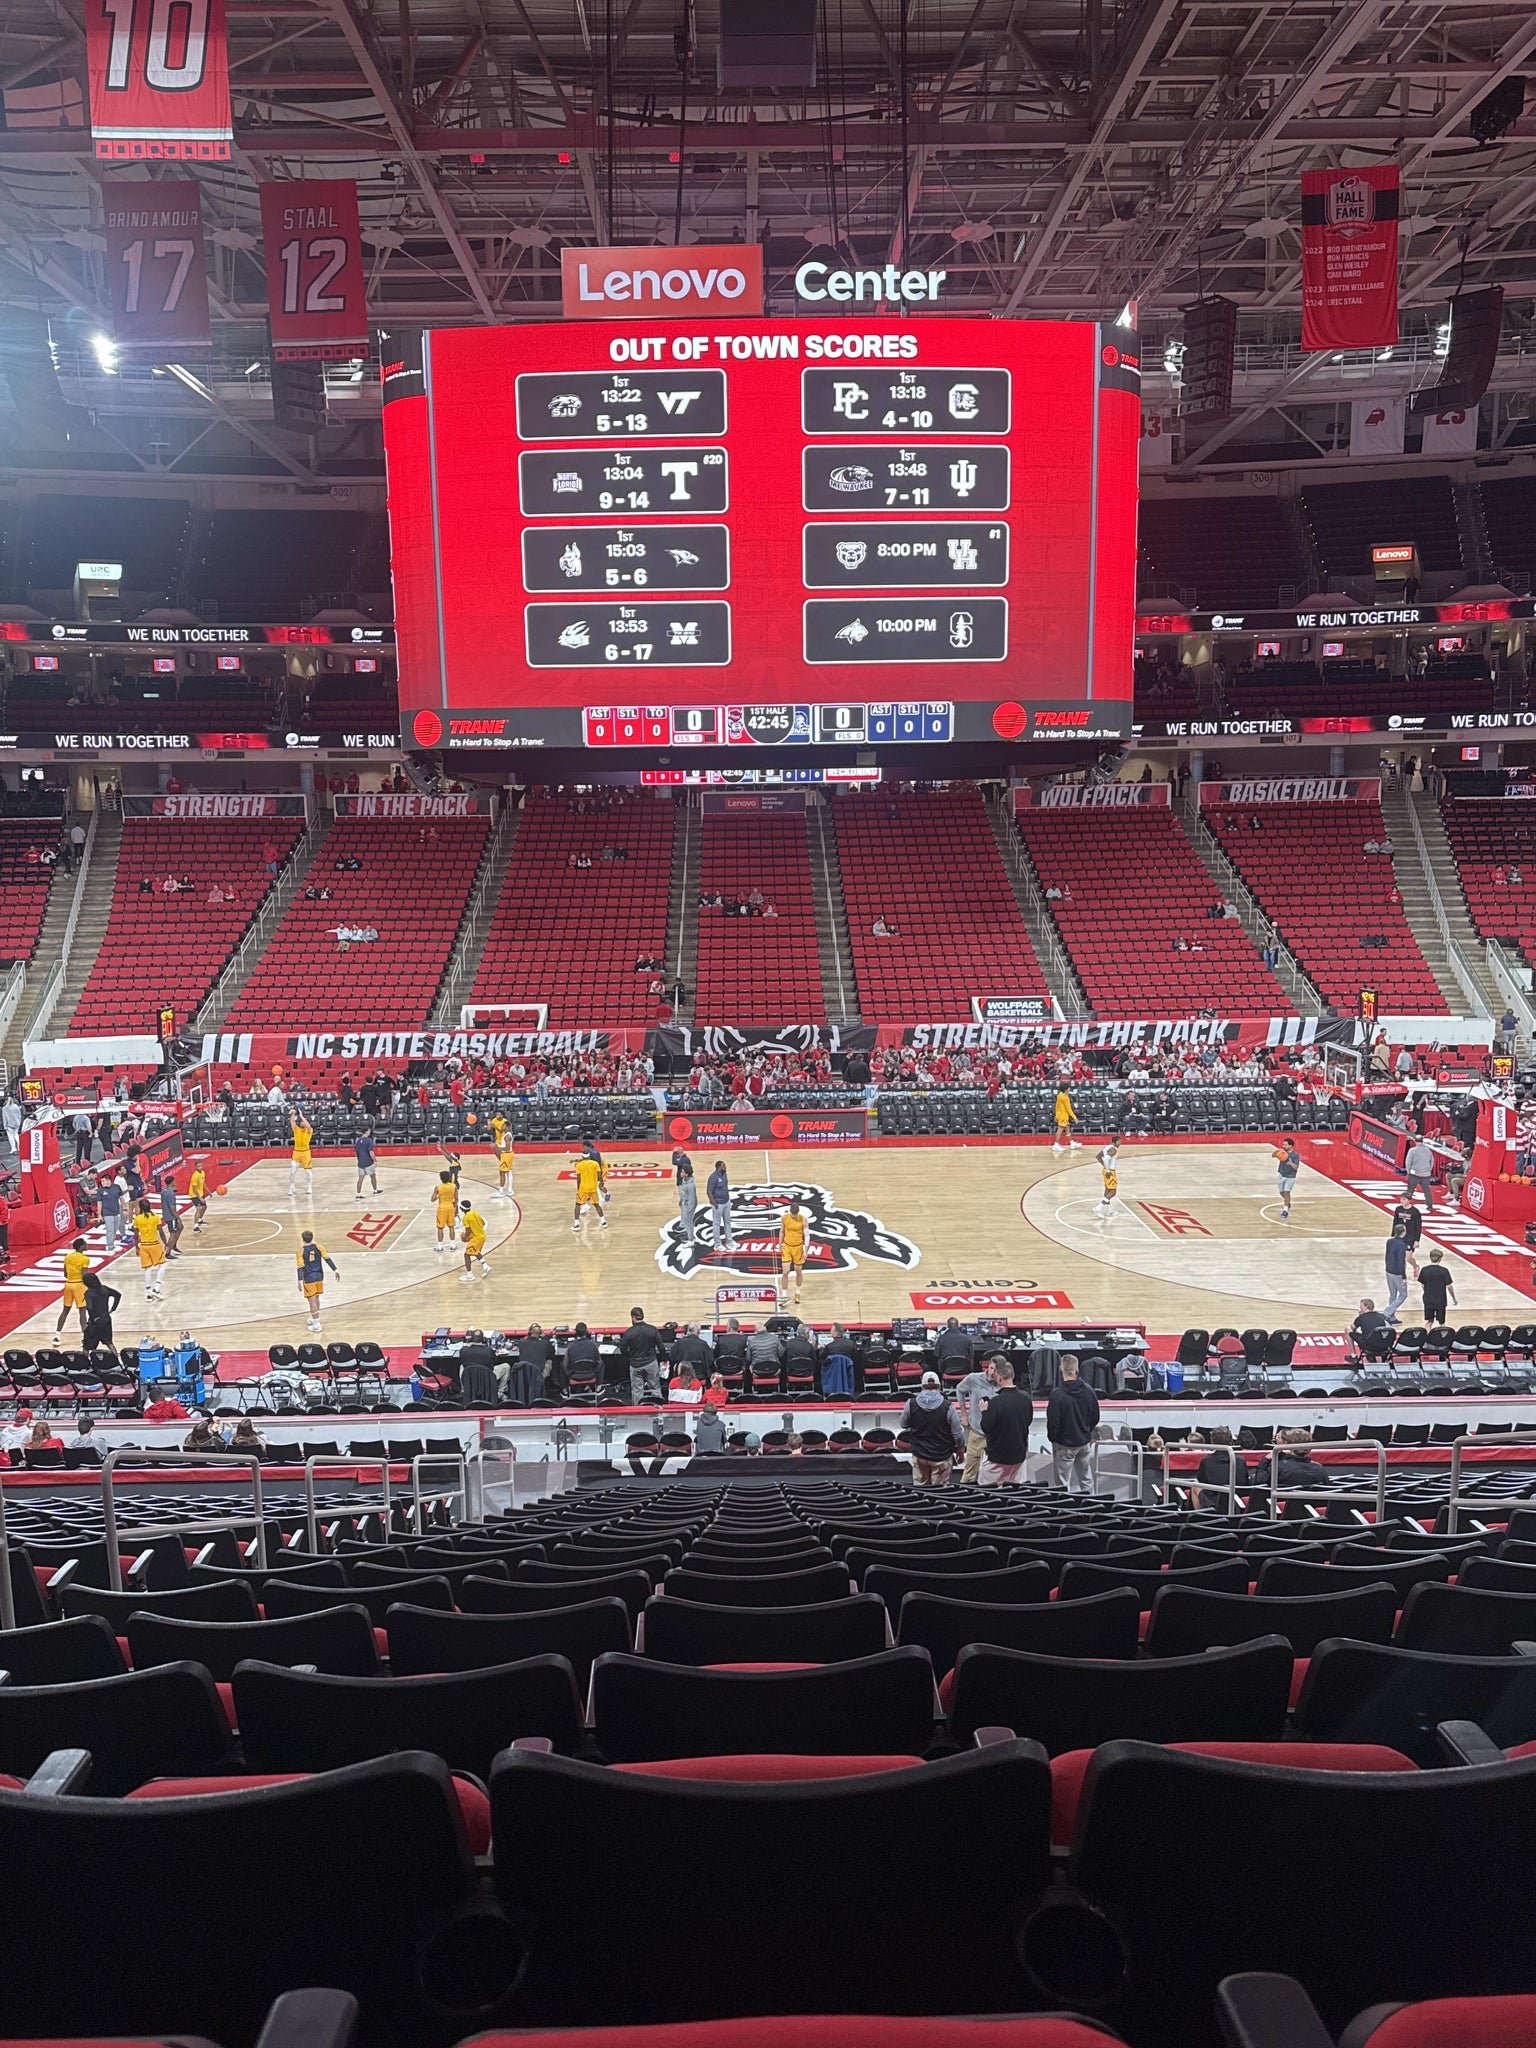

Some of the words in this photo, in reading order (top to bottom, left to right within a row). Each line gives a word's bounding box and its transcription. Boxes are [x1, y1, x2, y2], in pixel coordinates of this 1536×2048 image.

[100, 0, 206, 92] 10
[1336, 191, 1365, 204] HALL
[283, 206, 338, 229] STAAL
[1336, 206, 1365, 219] FAME
[121, 239, 196, 313] 17
[279, 236, 349, 313] 12
[579, 262, 746, 300] Lenovo
[795, 260, 946, 300] Center
[609, 337, 666, 361] OUT
[672, 336, 709, 360] OF
[714, 335, 799, 359] TOWN
[805, 334, 919, 359] SCORES
[612, 375, 630, 388] 1ST
[900, 372, 916, 383] 1ST
[601, 389, 641, 403] 13:22
[889, 386, 926, 399] 13:18
[551, 407, 577, 417] SJU
[625, 414, 648, 431] 13
[911, 410, 933, 428] 10
[614, 453, 632, 465] 1ST
[703, 454, 723, 465] #20
[900, 449, 916, 461] 1ST
[603, 467, 643, 480] 13:04
[888, 463, 927, 476] 13:48
[829, 478, 874, 492] MILWAUKEE
[627, 491, 650, 509] 14
[912, 488, 930, 505] 11
[617, 530, 634, 542] 1ST
[989, 529, 1001, 539] #1
[605, 544, 646, 557] 15:03
[877, 543, 911, 557] 8:00
[913, 543, 937, 556] PM
[1376, 549, 1409, 560] Lenovo
[633, 568, 648, 585] 6
[619, 606, 636, 618] 1ST
[1297, 613, 1316, 627] WE
[1319, 612, 1346, 626] RUN
[1350, 609, 1419, 625] TOGETHER
[609, 620, 648, 633] 13:53
[876, 618, 913, 632] 10:00
[915, 618, 937, 631] PM
[128, 628, 150, 641] WE
[152, 628, 179, 641] RUN
[182, 629, 249, 642] TOGETHER
[633, 643, 653, 660] 17
[591, 707, 610, 718] AST
[619, 707, 637, 718] STL
[650, 707, 664, 718] TO
[750, 707, 765, 715] 1ST
[766, 706, 787, 714] HALF
[872, 704, 888, 714] AST
[900, 704, 917, 714] STL
[931, 703, 944, 713] TO
[687, 710, 702, 731] 0
[748, 715, 789, 729] 42:45
[836, 708, 850, 729] 0
[1034, 711, 1090, 726] TRANE
[1451, 714, 1474, 728] WE
[1478, 713, 1508, 727] RUN
[450, 719, 506, 734] TRANE
[595, 725, 604, 737] 0
[624, 725, 633, 737] 0
[652, 724, 661, 737] 0
[876, 721, 885, 733] 0
[904, 720, 914, 733] 0
[932, 720, 941, 732] 0
[1166, 722, 1187, 735] WE
[1190, 722, 1217, 735] RUN
[1221, 720, 1292, 734] TOGETHER
[343, 734, 364, 747] WE
[367, 734, 395, 747] RUN
[1046, 730, 1065, 738] Hard
[1067, 730, 1076, 738] To
[1077, 730, 1094, 739] Stop
[55, 735, 79, 748] WE
[82, 735, 113, 748] RUN
[116, 735, 189, 748] TOGETHER
[462, 738, 482, 747] Hard
[483, 738, 492, 746] To
[494, 738, 512, 747] Stop
[1041, 784, 1144, 807] WOLFPACK
[1229, 780, 1350, 802] BASKETBALL
[164, 796, 266, 817] STRENGTH
[356, 796, 375, 816] IN
[377, 796, 414, 816] THE
[418, 795, 469, 816] PACK
[727, 799, 757, 807] Lenovo
[987, 1001, 1043, 1009] WOLFPACK
[911, 1022, 1052, 1049] STRENGTH
[1058, 1023, 1089, 1047] IN
[1099, 1020, 1150, 1046] THE
[1153, 1019, 1230, 1045] PACK
[296, 1034, 338, 1059] NC
[339, 1033, 428, 1059] STATE
[432, 1030, 600, 1058] BASKETBALL
[1496, 1066, 1508, 1076] 30
[26, 1090, 39, 1099] 30
[697, 1123, 736, 1132] TRANE
[798, 1121, 837, 1130] TRANE
[1469, 1186, 1483, 1201] CPI
[55, 1209, 69, 1223] CPI
[346, 1212, 394, 1246] ACC
[926, 1279, 1039, 1288] Center
[728, 1290, 738, 1298] NC
[740, 1290, 766, 1298] STATE
[925, 1295, 1058, 1305] Lenovo
